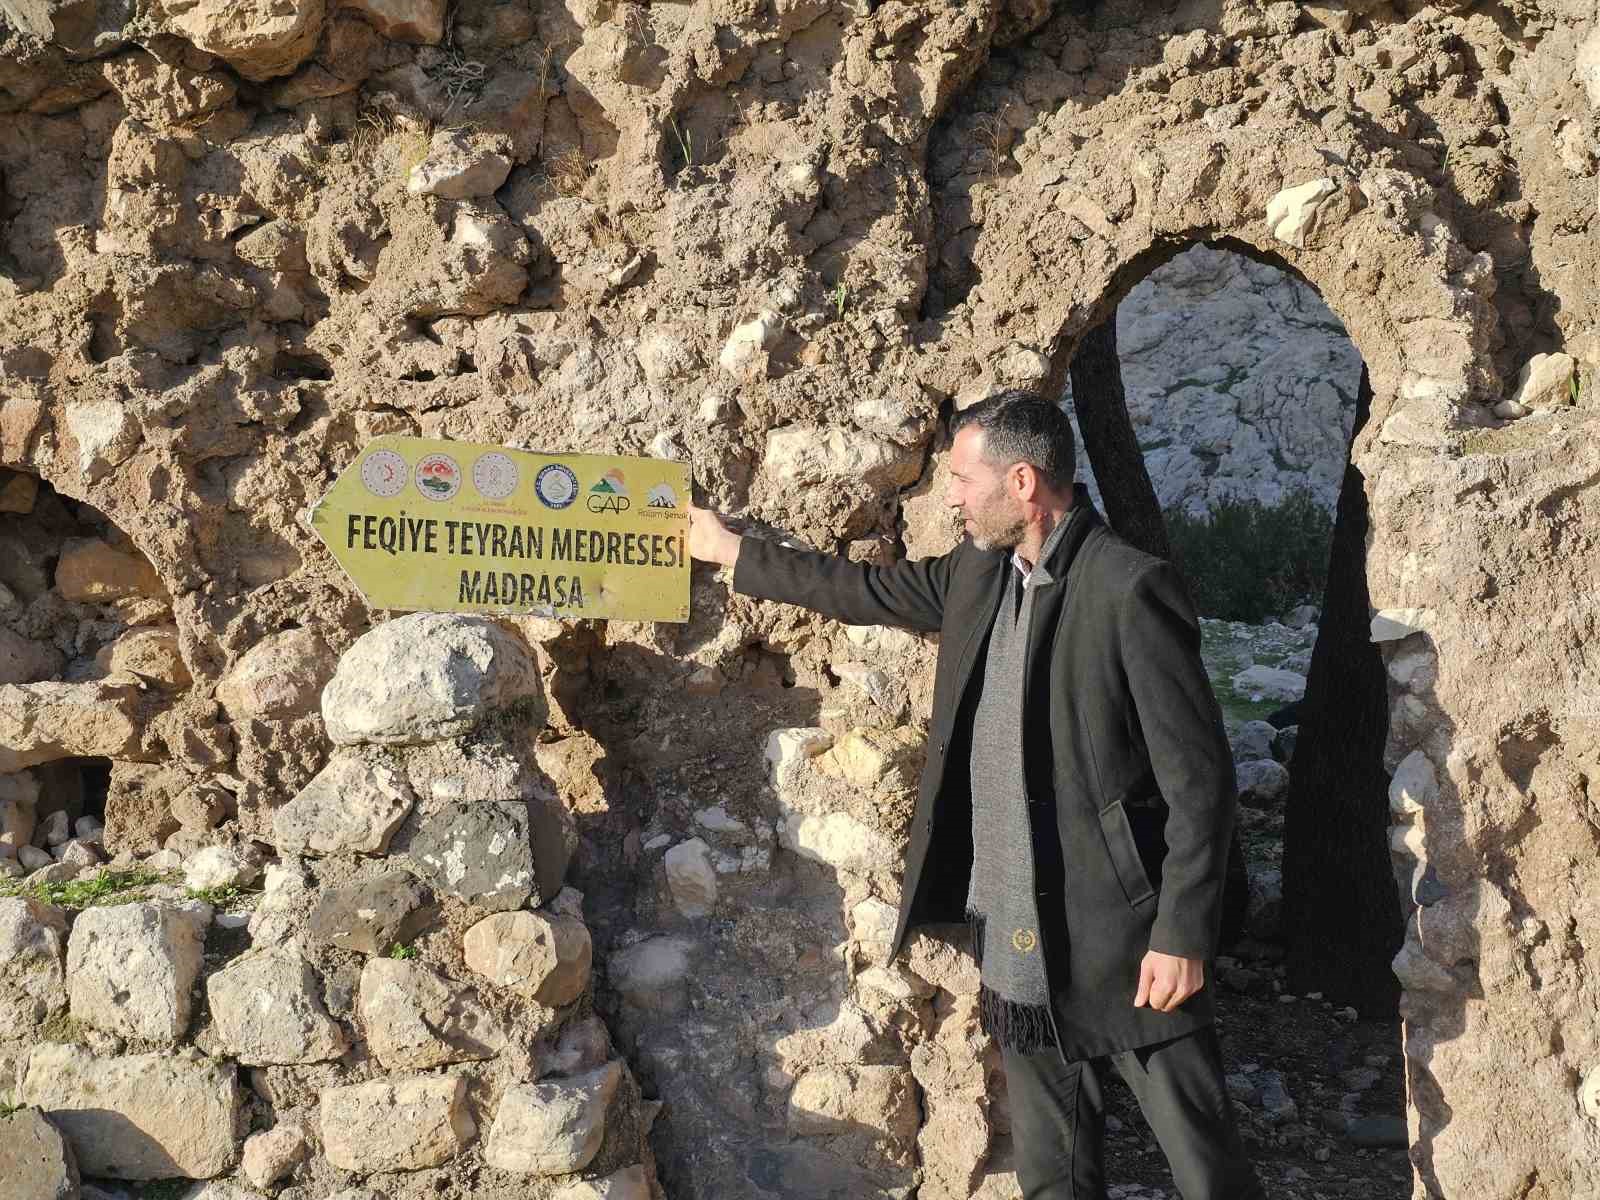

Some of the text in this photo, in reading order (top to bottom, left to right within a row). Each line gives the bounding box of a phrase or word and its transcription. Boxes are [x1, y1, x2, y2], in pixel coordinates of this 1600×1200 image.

[586, 494, 631, 515] GAP
[347, 510, 685, 568] FEQİYE TEYRAN MEDRESESİ
[458, 570, 585, 609] MADRASA
